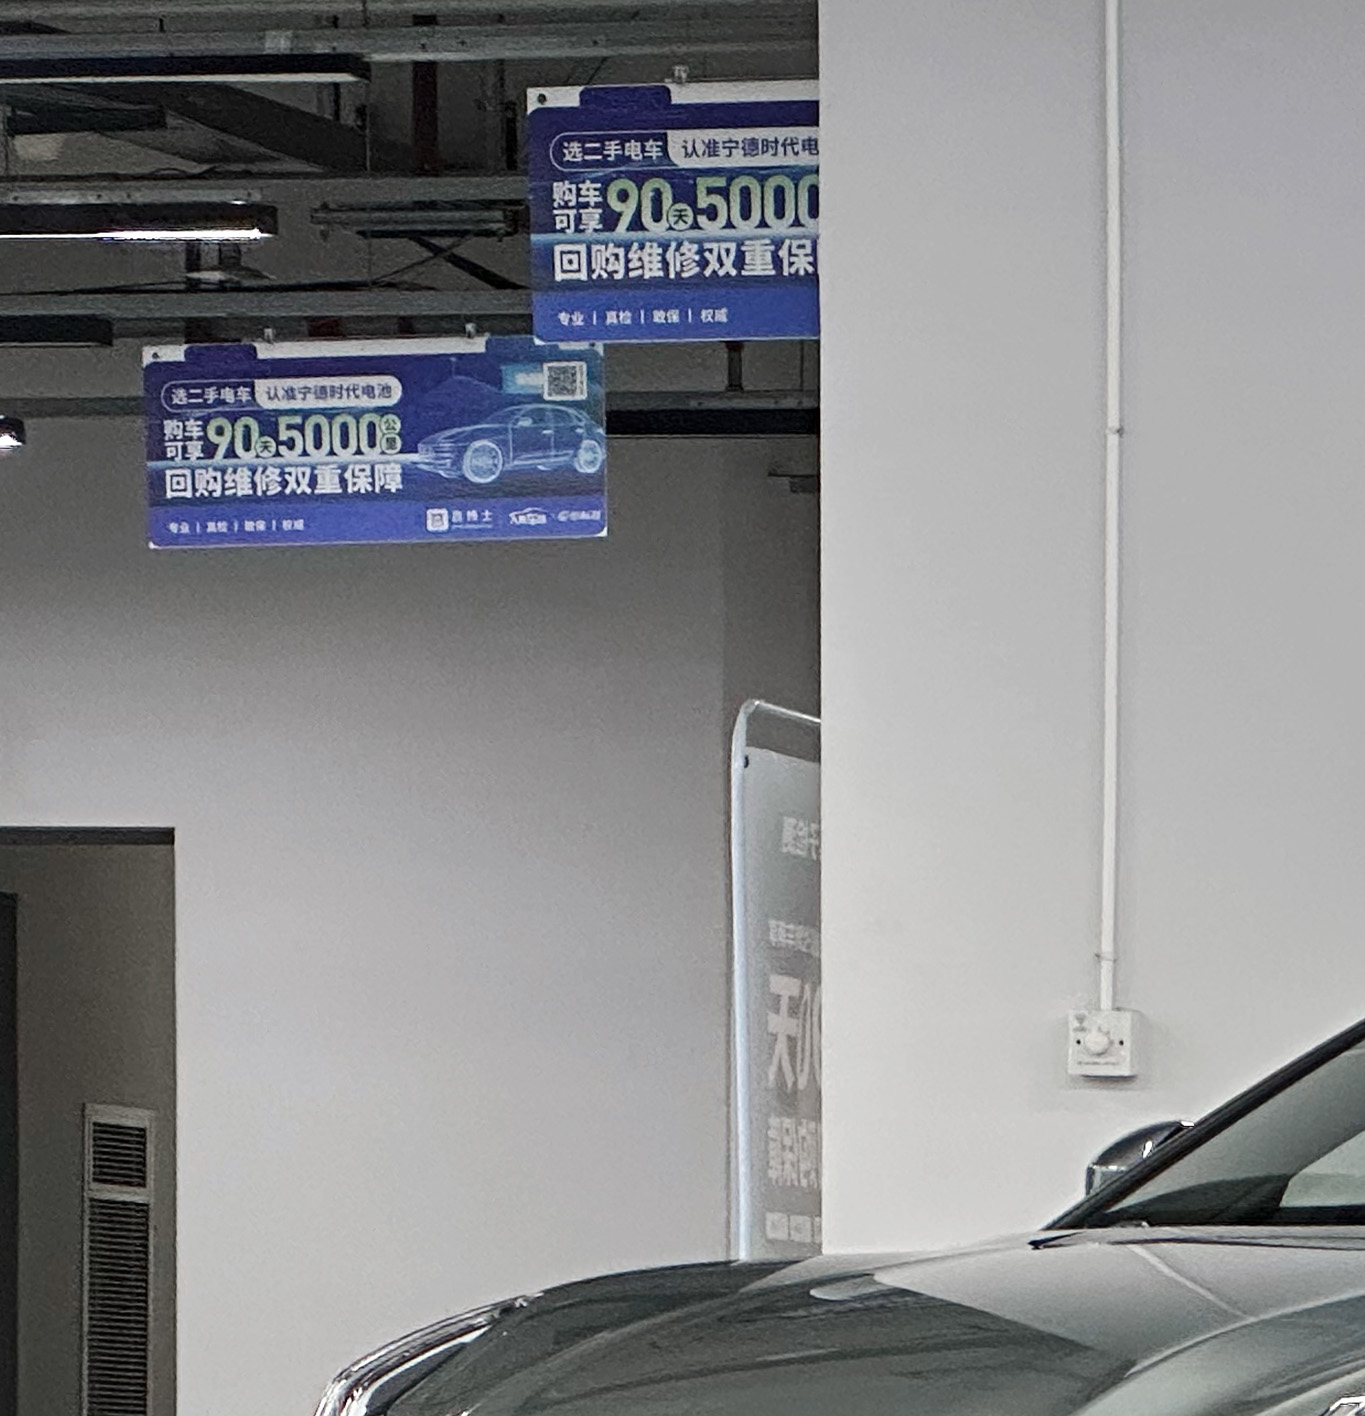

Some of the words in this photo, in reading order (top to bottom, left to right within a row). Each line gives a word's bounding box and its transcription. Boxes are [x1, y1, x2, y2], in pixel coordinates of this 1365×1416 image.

[562, 138, 664, 162] 选二手电车
[552, 180, 603, 209] 购车
[553, 208, 603, 234] 可享
[553, 238, 818, 281] 回购维修双重保
[171, 386, 252, 405] 选二手电车
[266, 382, 392, 401] 认准宁德时代电池
[163, 418, 204, 441] 购车
[165, 463, 403, 499] 回购维修双重保障
